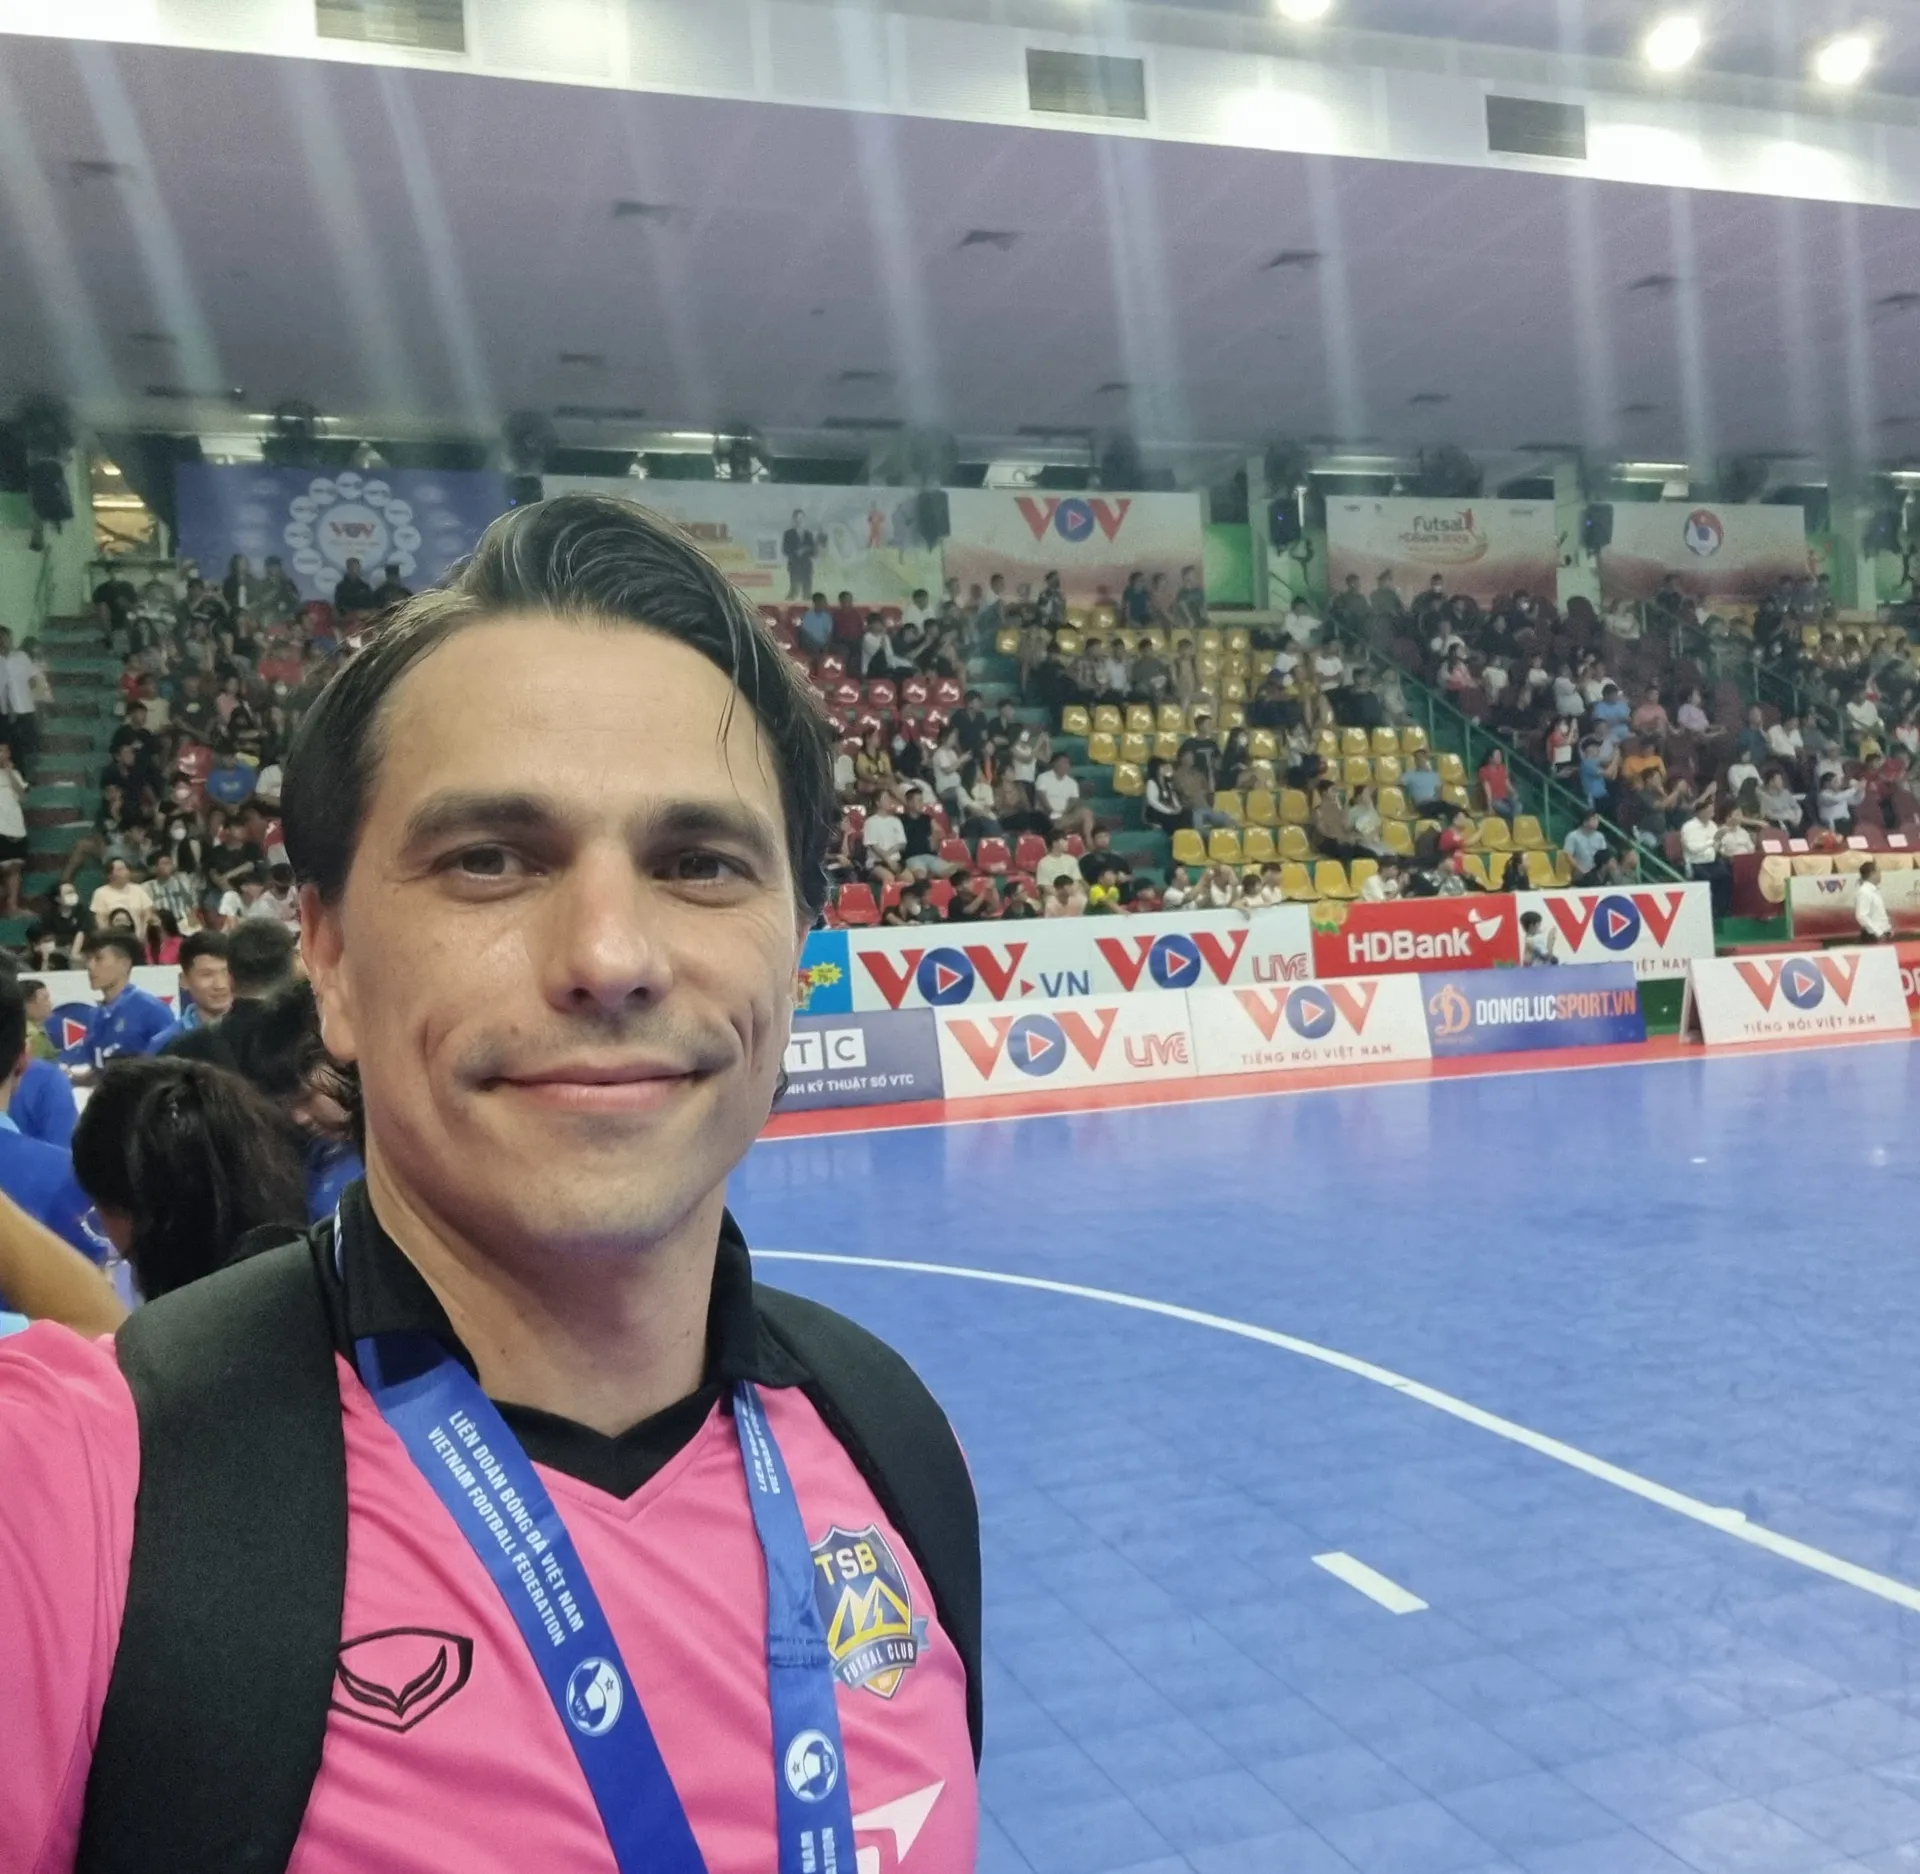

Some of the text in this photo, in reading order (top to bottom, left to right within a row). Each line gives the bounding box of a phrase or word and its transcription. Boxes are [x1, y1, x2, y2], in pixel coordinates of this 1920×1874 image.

[1014, 497, 1132, 543] VOV
[1348, 927, 1473, 964] HDBank
[1543, 892, 1686, 955] VOV
[857, 942, 1029, 1009] VOV
[1094, 929, 1309, 992] VOV LIVE
[1732, 954, 1862, 1014] VOV
[1232, 981, 1379, 1043] VOV
[1848, 1013, 1877, 1027] NAM
[790, 1035, 857, 1066] TC
[945, 1007, 1189, 1082] VOV LIVE
[1360, 1042, 1393, 1056] NAM
[889, 1073, 915, 1087] VTC
[427, 1426, 566, 1648] VIETNAM FOOTBALL FEDERATION
[448, 1410, 481, 1449] LIÊN
[558, 1590, 585, 1633] NAM
[814, 1541, 878, 1586] TSB
[843, 1641, 915, 1684] FUTSAL CLUB
